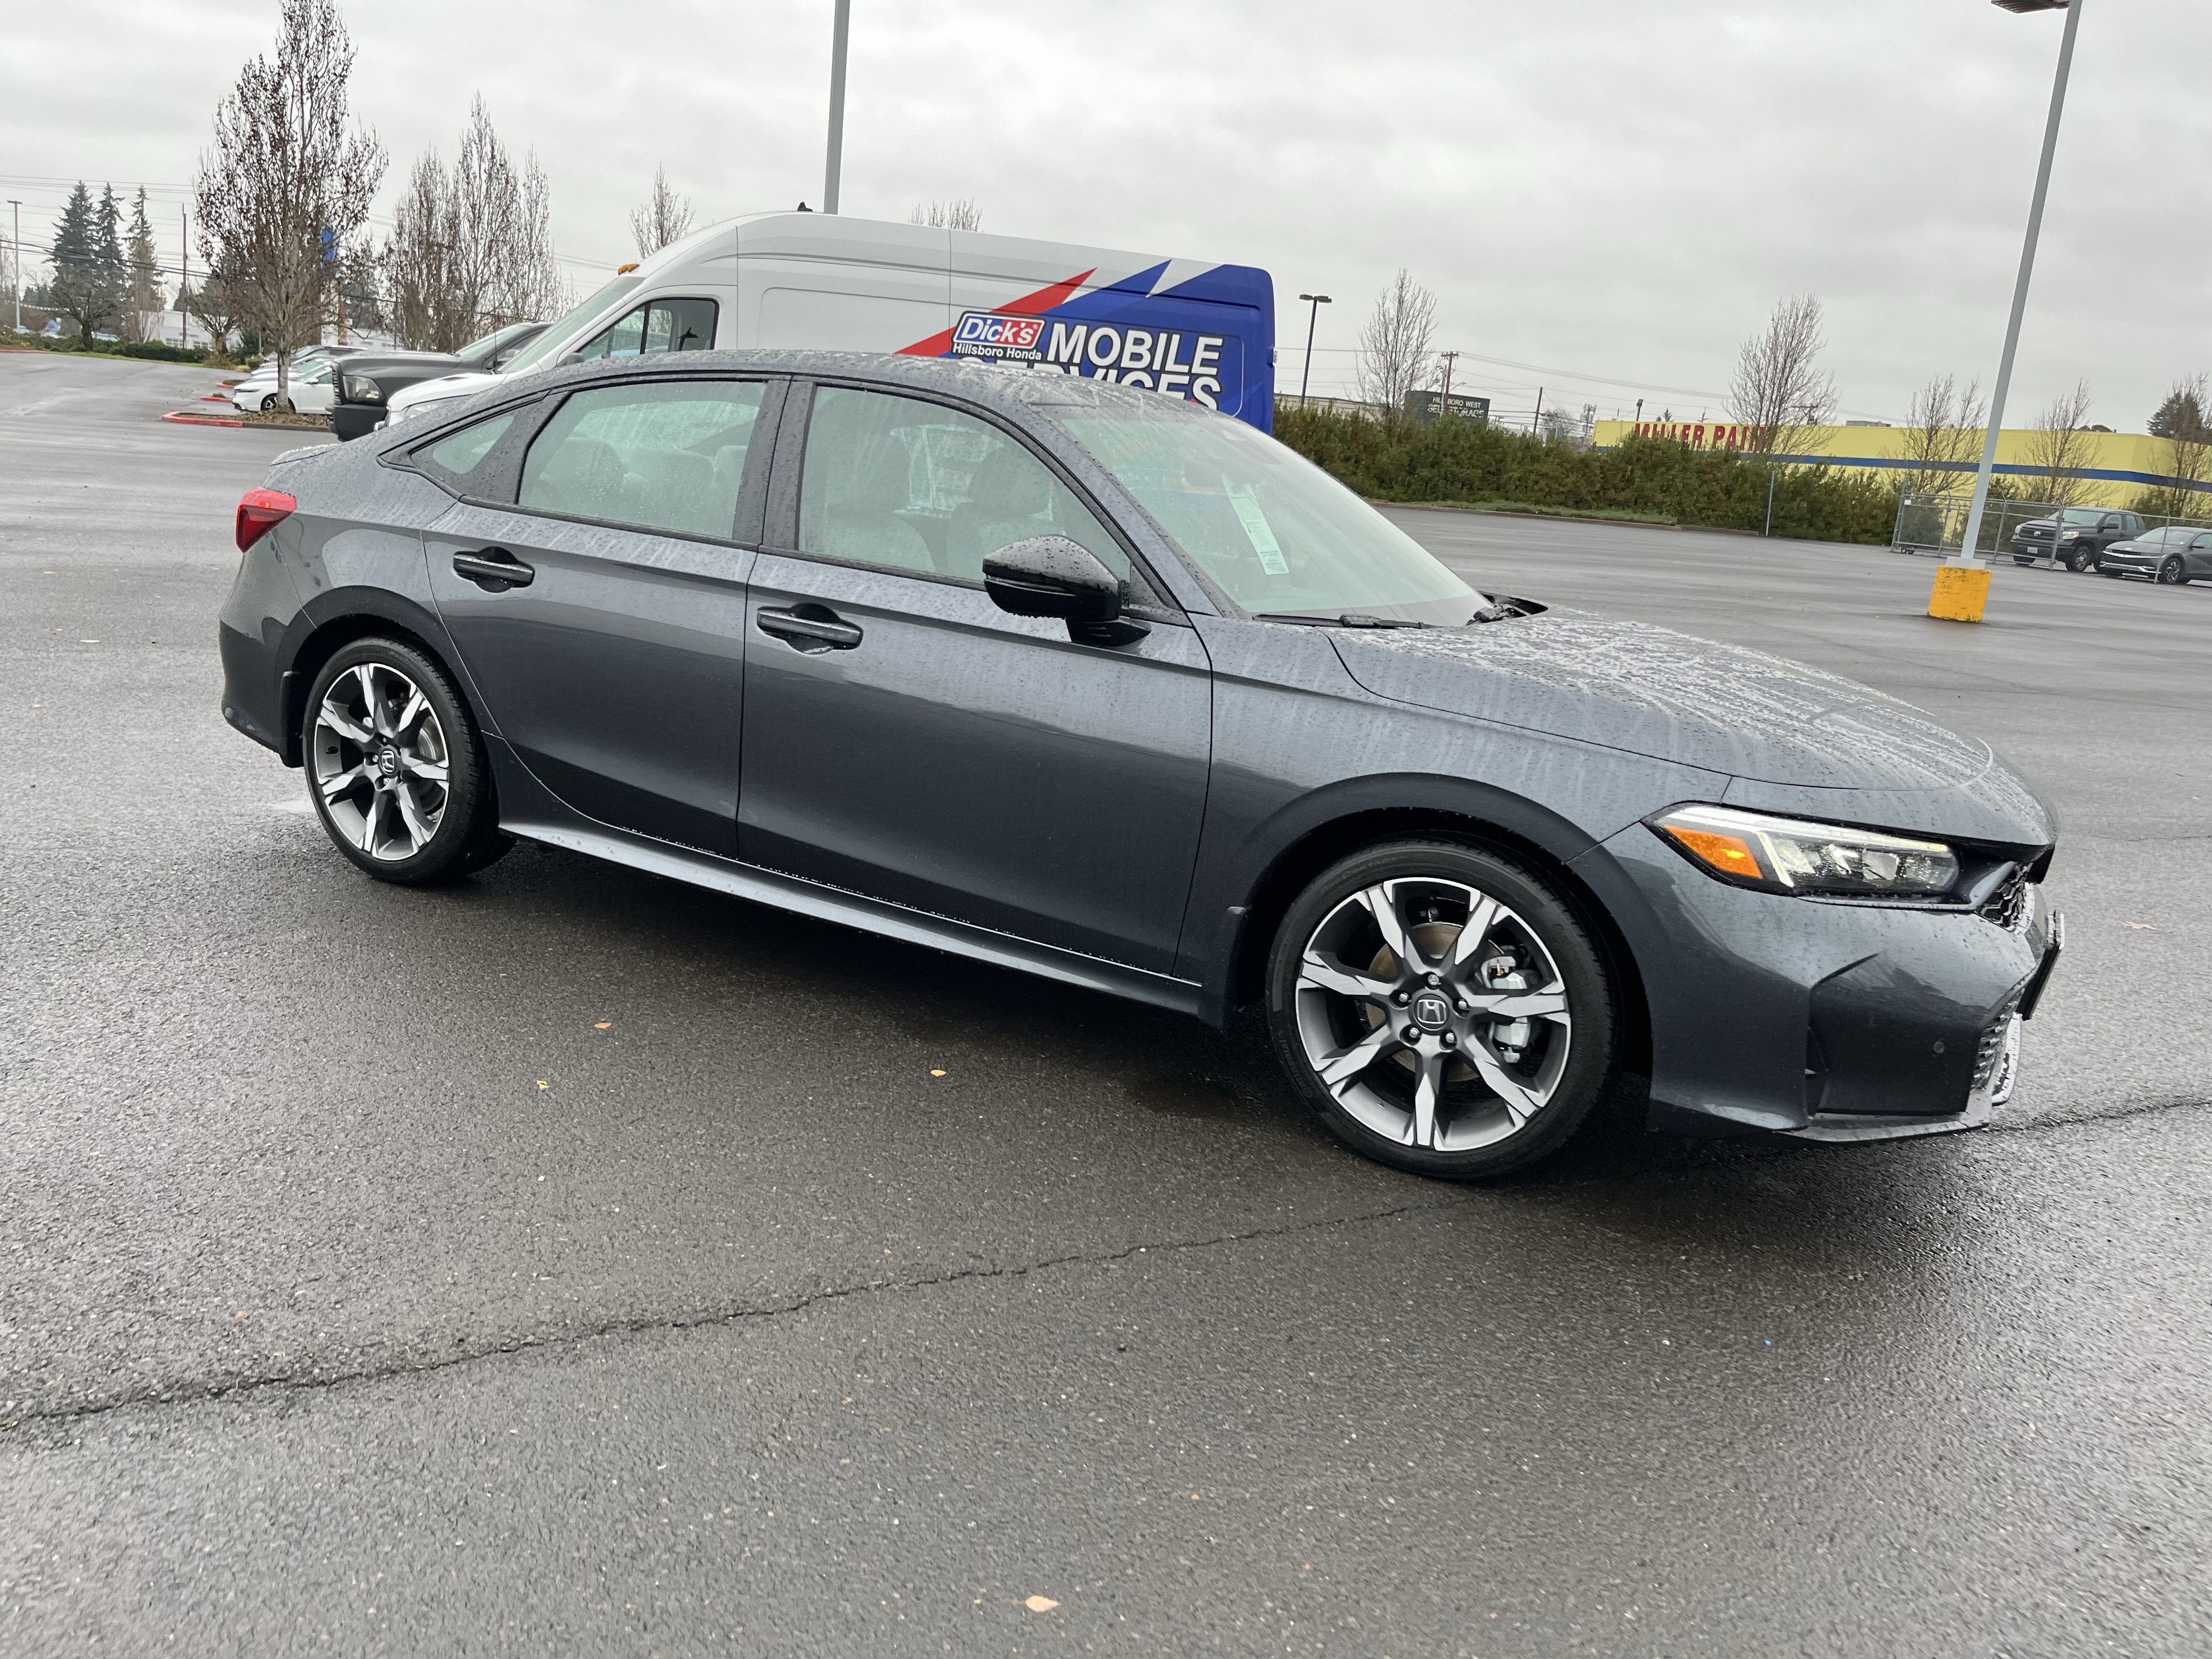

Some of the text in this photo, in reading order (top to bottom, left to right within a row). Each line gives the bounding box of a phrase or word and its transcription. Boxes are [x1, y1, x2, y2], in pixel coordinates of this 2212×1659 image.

[952, 342, 1042, 360] Hillsboro Honda
[1047, 323, 1223, 375] MOBILE
[1432, 396, 1464, 407] HILBORO
